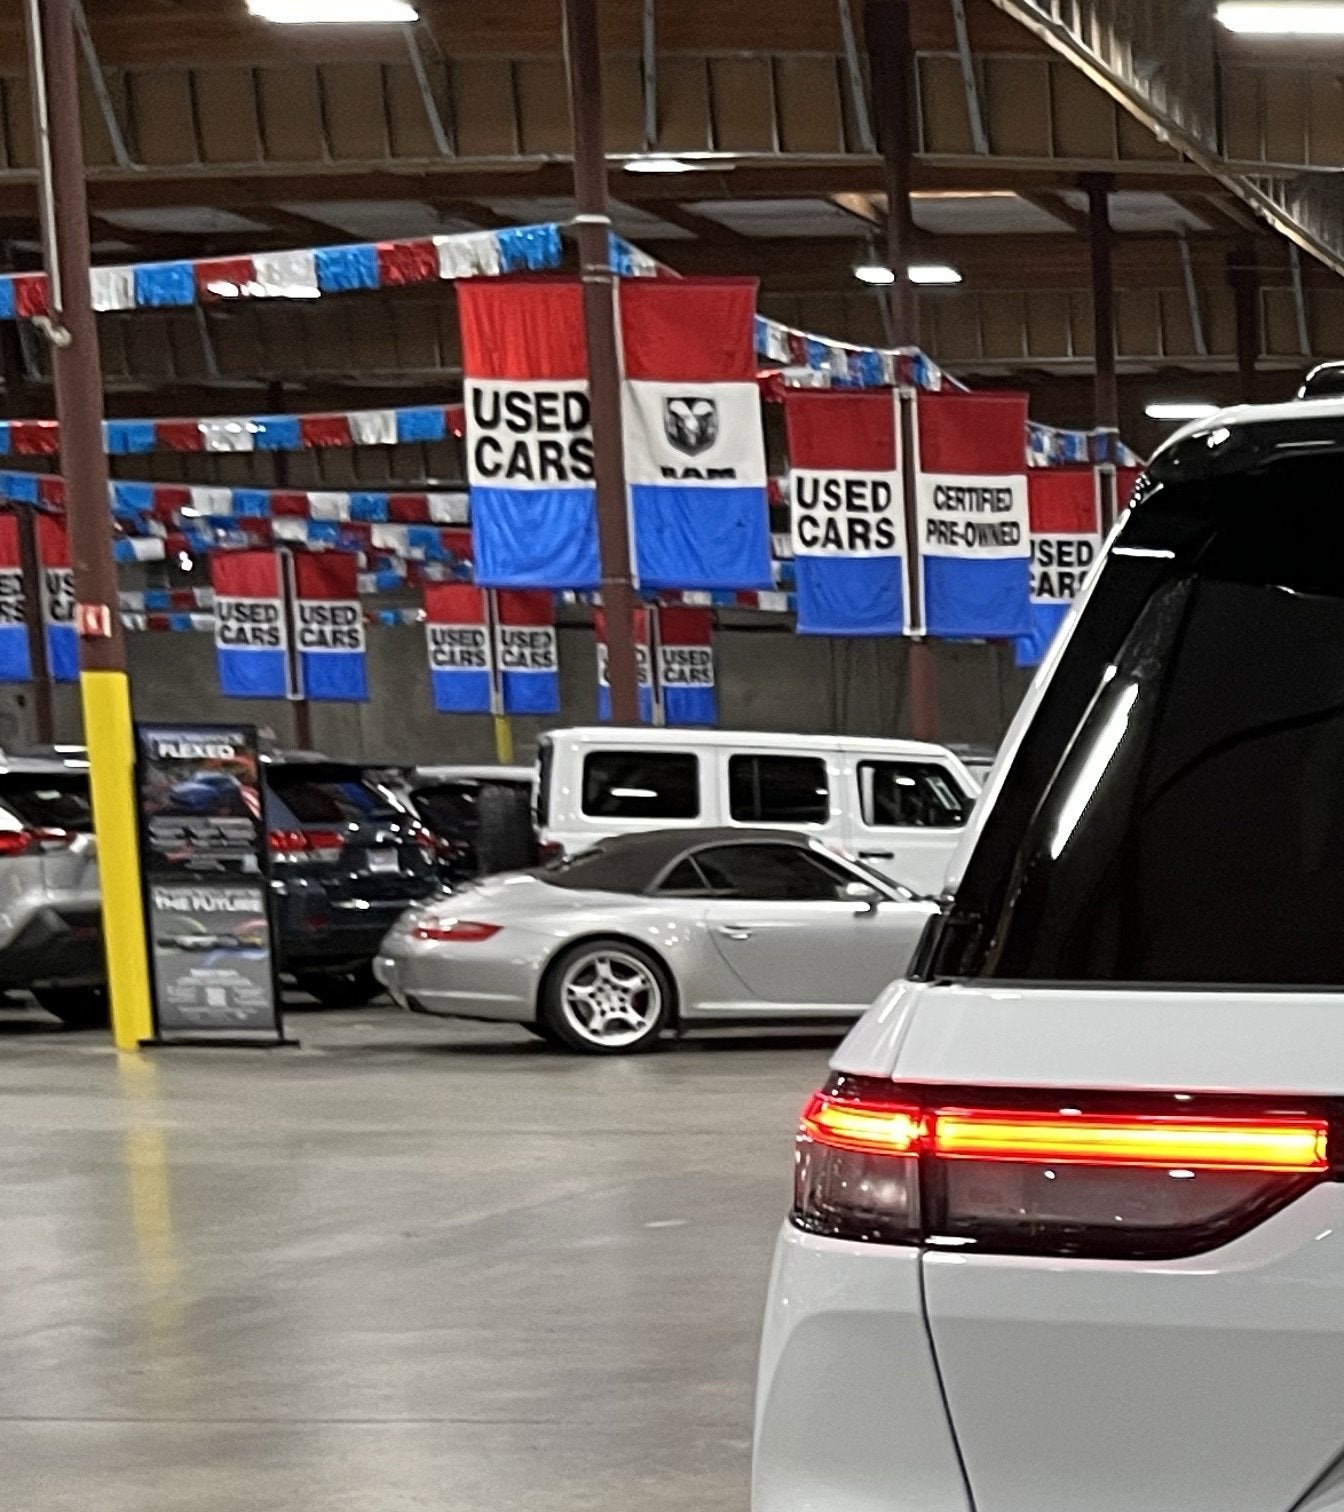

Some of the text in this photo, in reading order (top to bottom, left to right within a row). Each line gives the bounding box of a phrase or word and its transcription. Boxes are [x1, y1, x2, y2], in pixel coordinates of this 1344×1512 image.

[472, 388, 591, 433] USED
[474, 436, 595, 481] CARS
[660, 465, 737, 480] RAM
[796, 477, 892, 513] USED
[933, 485, 1013, 513] CERTIFIED
[797, 516, 896, 550] CARS
[926, 519, 1021, 547] PRE-OWNED
[1030, 571, 1087, 598] AR
[218, 602, 279, 623] USED
[299, 604, 357, 625] USED
[219, 625, 280, 646] CARS
[300, 628, 360, 648] CARS
[431, 629, 485, 647] USED
[500, 630, 552, 648] USED
[432, 649, 487, 667] CARS
[502, 650, 553, 668] CARS
[662, 649, 710, 666] USED
[664, 666, 711, 683] CARS
